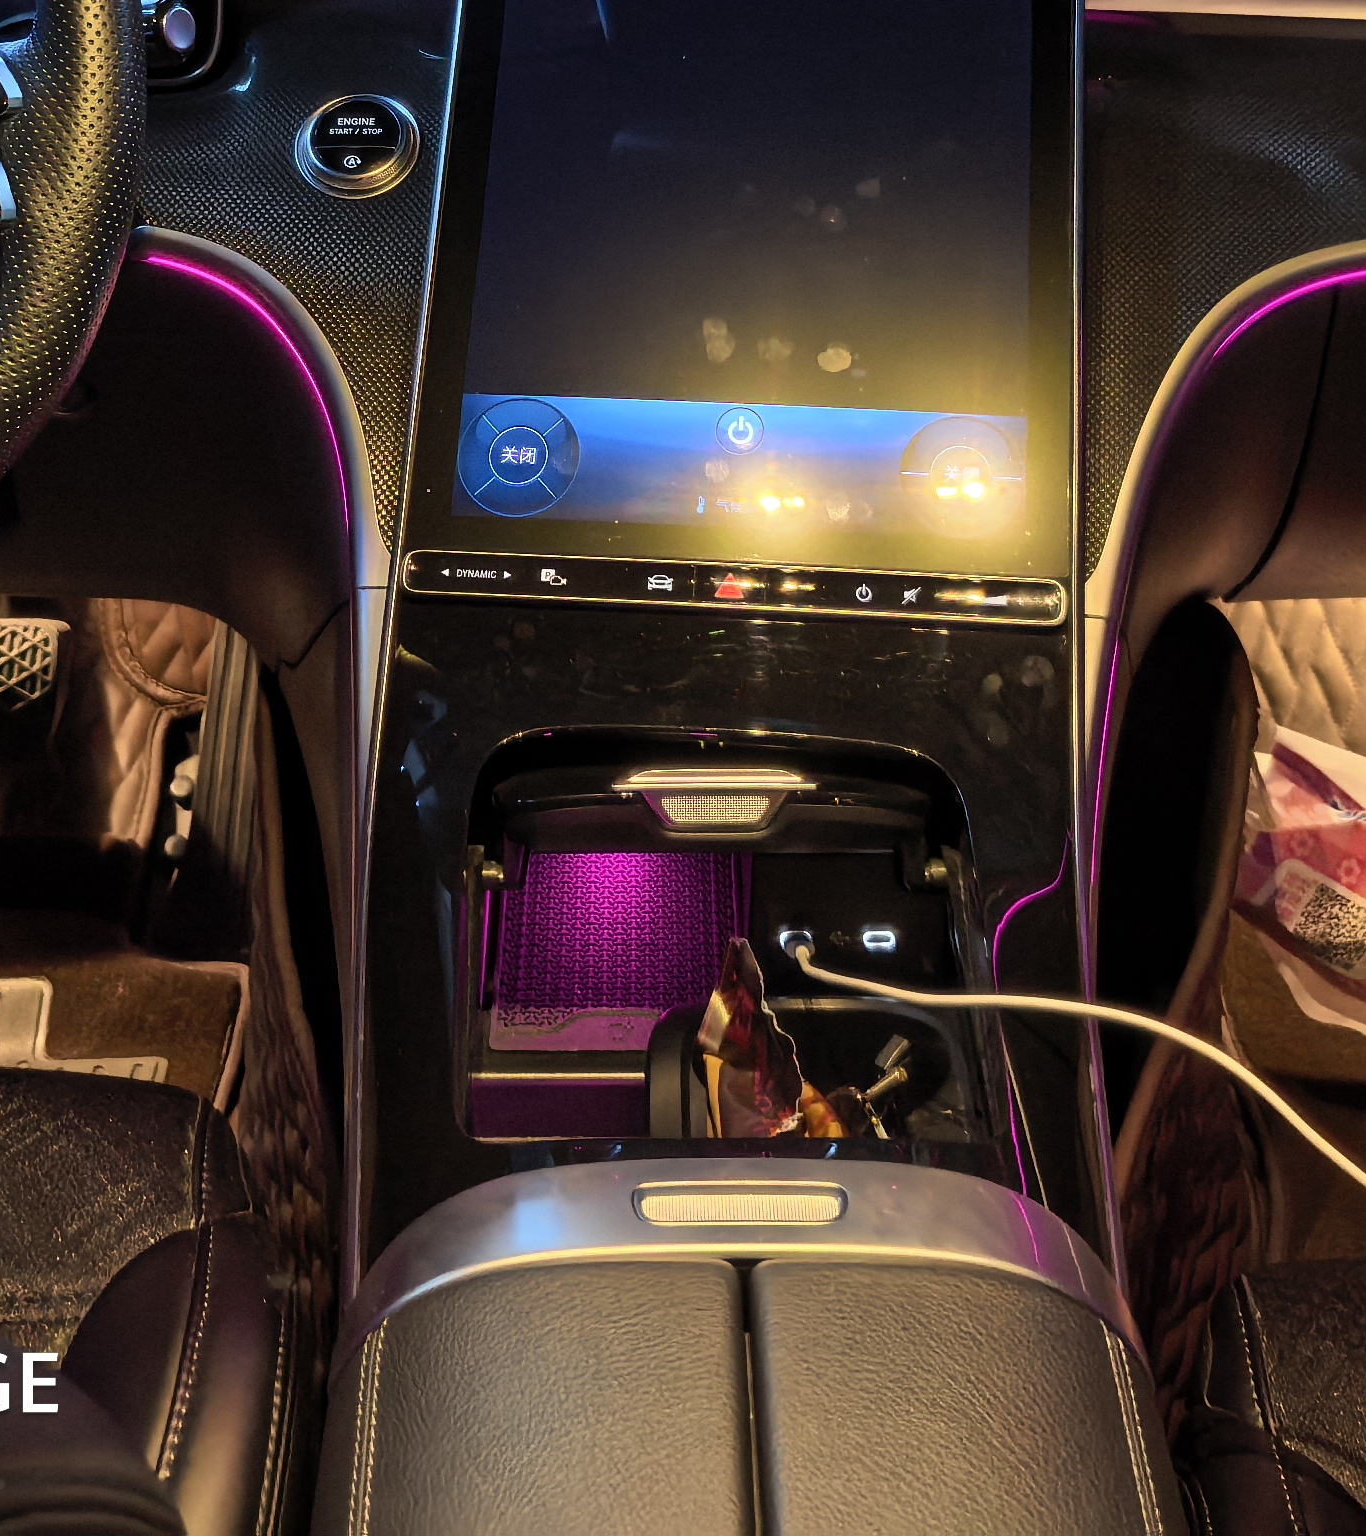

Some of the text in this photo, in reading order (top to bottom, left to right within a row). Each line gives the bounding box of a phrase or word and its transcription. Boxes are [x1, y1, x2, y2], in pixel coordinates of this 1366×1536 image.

[337, 117, 376, 126] ENGINE
[500, 445, 537, 465] 关闭
[456, 568, 497, 579] DYNAMIC
